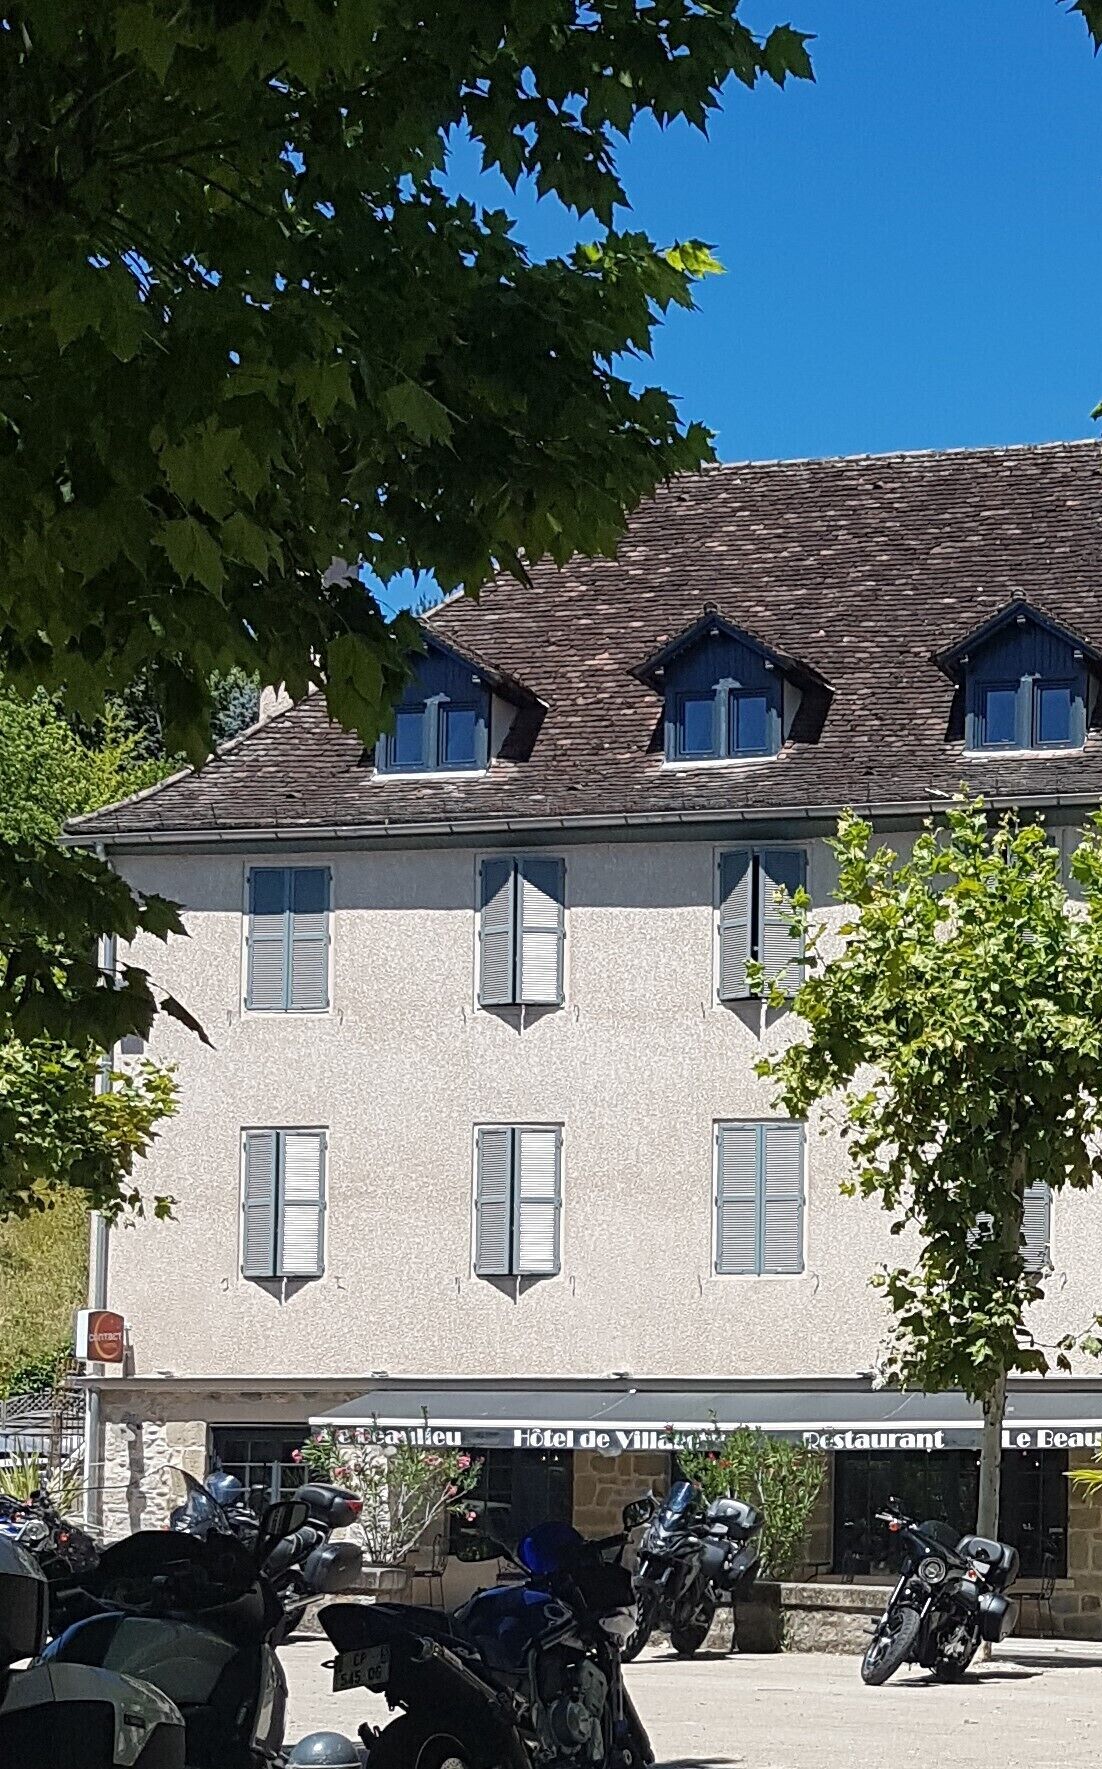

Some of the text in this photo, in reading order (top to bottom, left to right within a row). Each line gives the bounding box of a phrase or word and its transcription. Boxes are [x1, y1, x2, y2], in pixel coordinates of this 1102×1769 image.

[513, 1428, 574, 1447] Hôtel
[580, 1430, 610, 1448] de
[802, 1430, 945, 1449] Restaurant
[1001, 1430, 1031, 1448] Le
